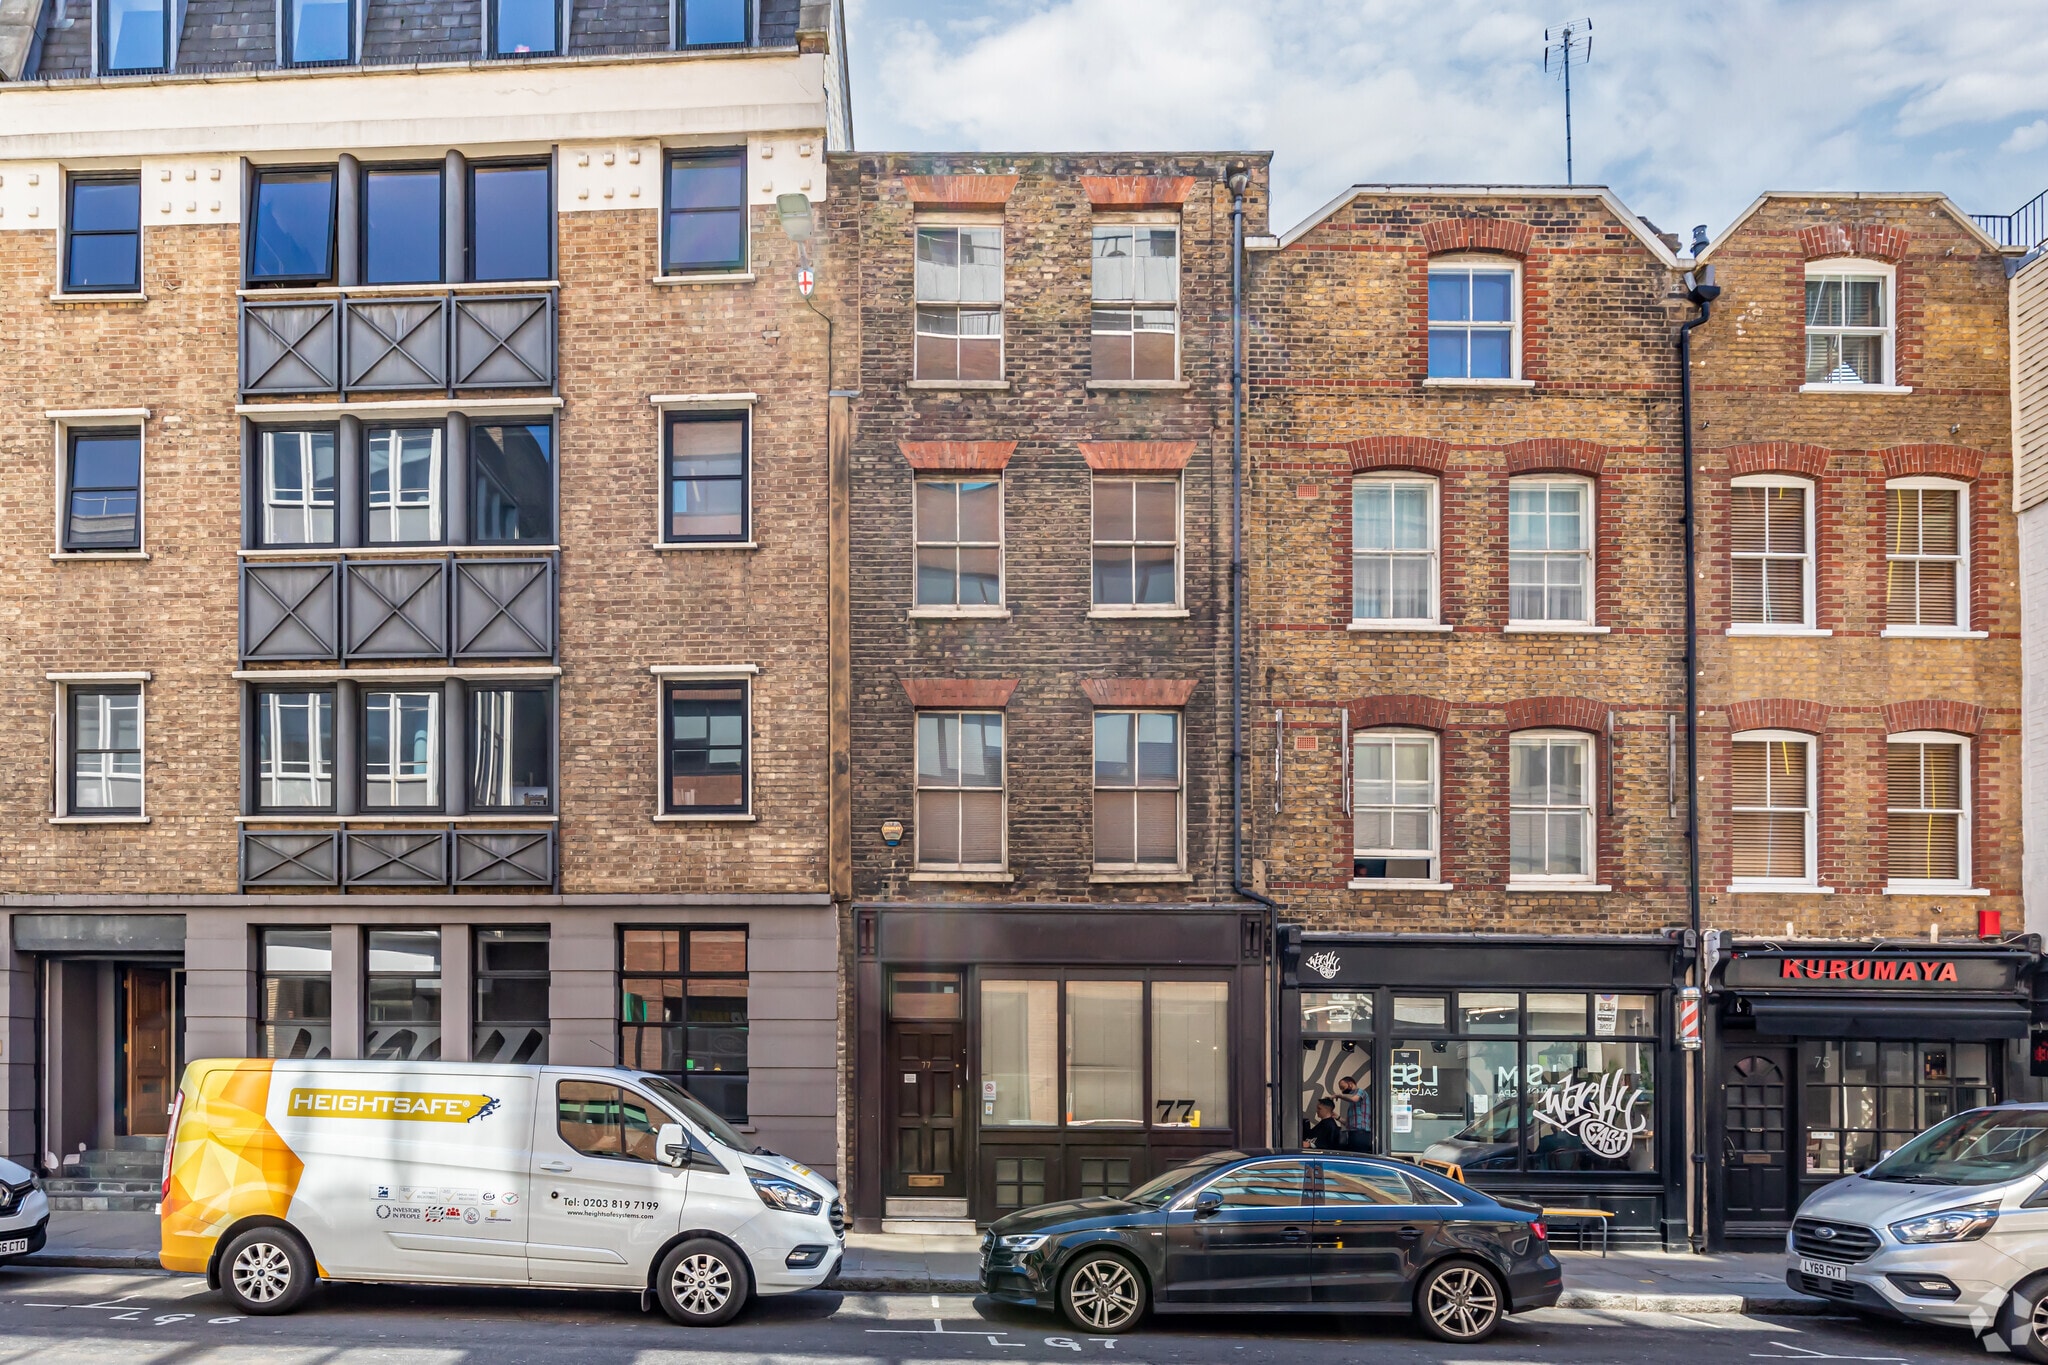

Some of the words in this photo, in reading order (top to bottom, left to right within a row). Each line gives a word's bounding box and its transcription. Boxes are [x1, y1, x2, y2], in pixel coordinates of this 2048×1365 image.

[1780, 959, 1958, 982] KURUMAYA
[921, 1061, 931, 1069] 77
[1814, 1056, 1831, 1069] 75
[294, 1094, 463, 1116] HEIGHTSAFE
[1156, 1099, 1195, 1123] 77
[563, 1197, 580, 1207] Tel:
[583, 1198, 608, 1208] 0203
[611, 1199, 631, 1209] 819
[633, 1200, 659, 1211] 7199
[567, 1210, 654, 1219] www.heightsafesystems.com
[9, 1240, 26, 1252] CTO
[1804, 1261, 1825, 1275] LY69
[1825, 1265, 1842, 1278] GYT
